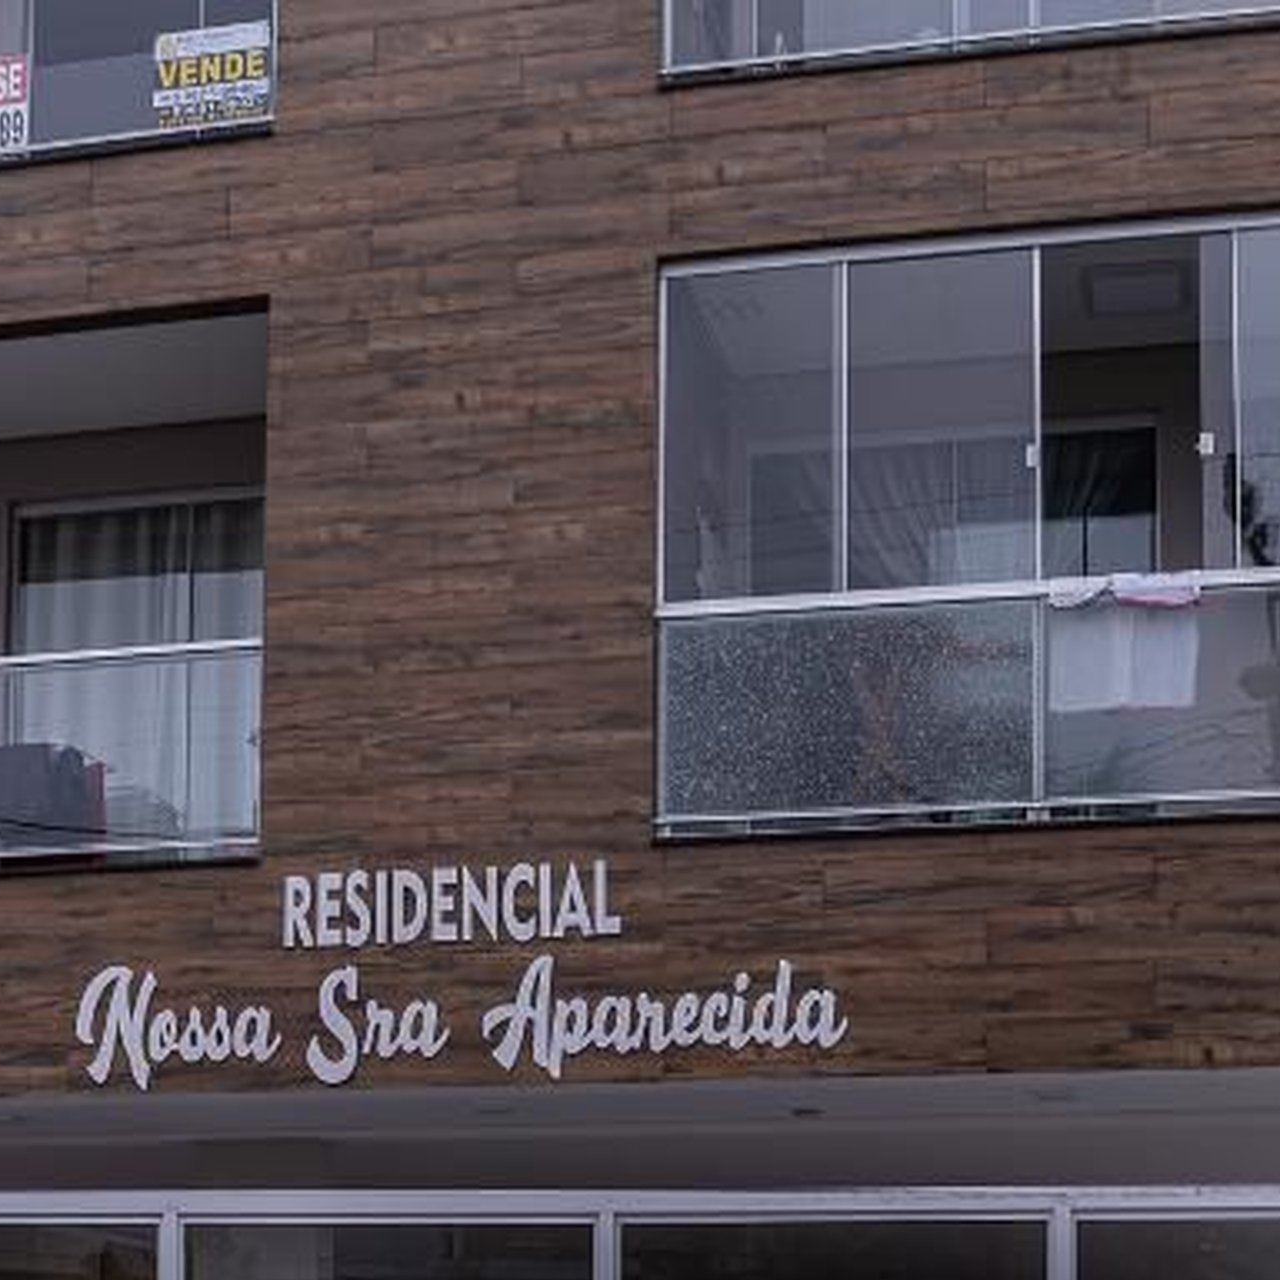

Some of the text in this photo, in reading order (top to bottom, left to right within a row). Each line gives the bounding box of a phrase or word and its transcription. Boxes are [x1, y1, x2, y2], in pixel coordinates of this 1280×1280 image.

[159, 49, 265, 88] VENDE
[283, 858, 621, 949] RESIDENCIAL
[77, 955, 849, 1091] Nossa Sra Aparecida
